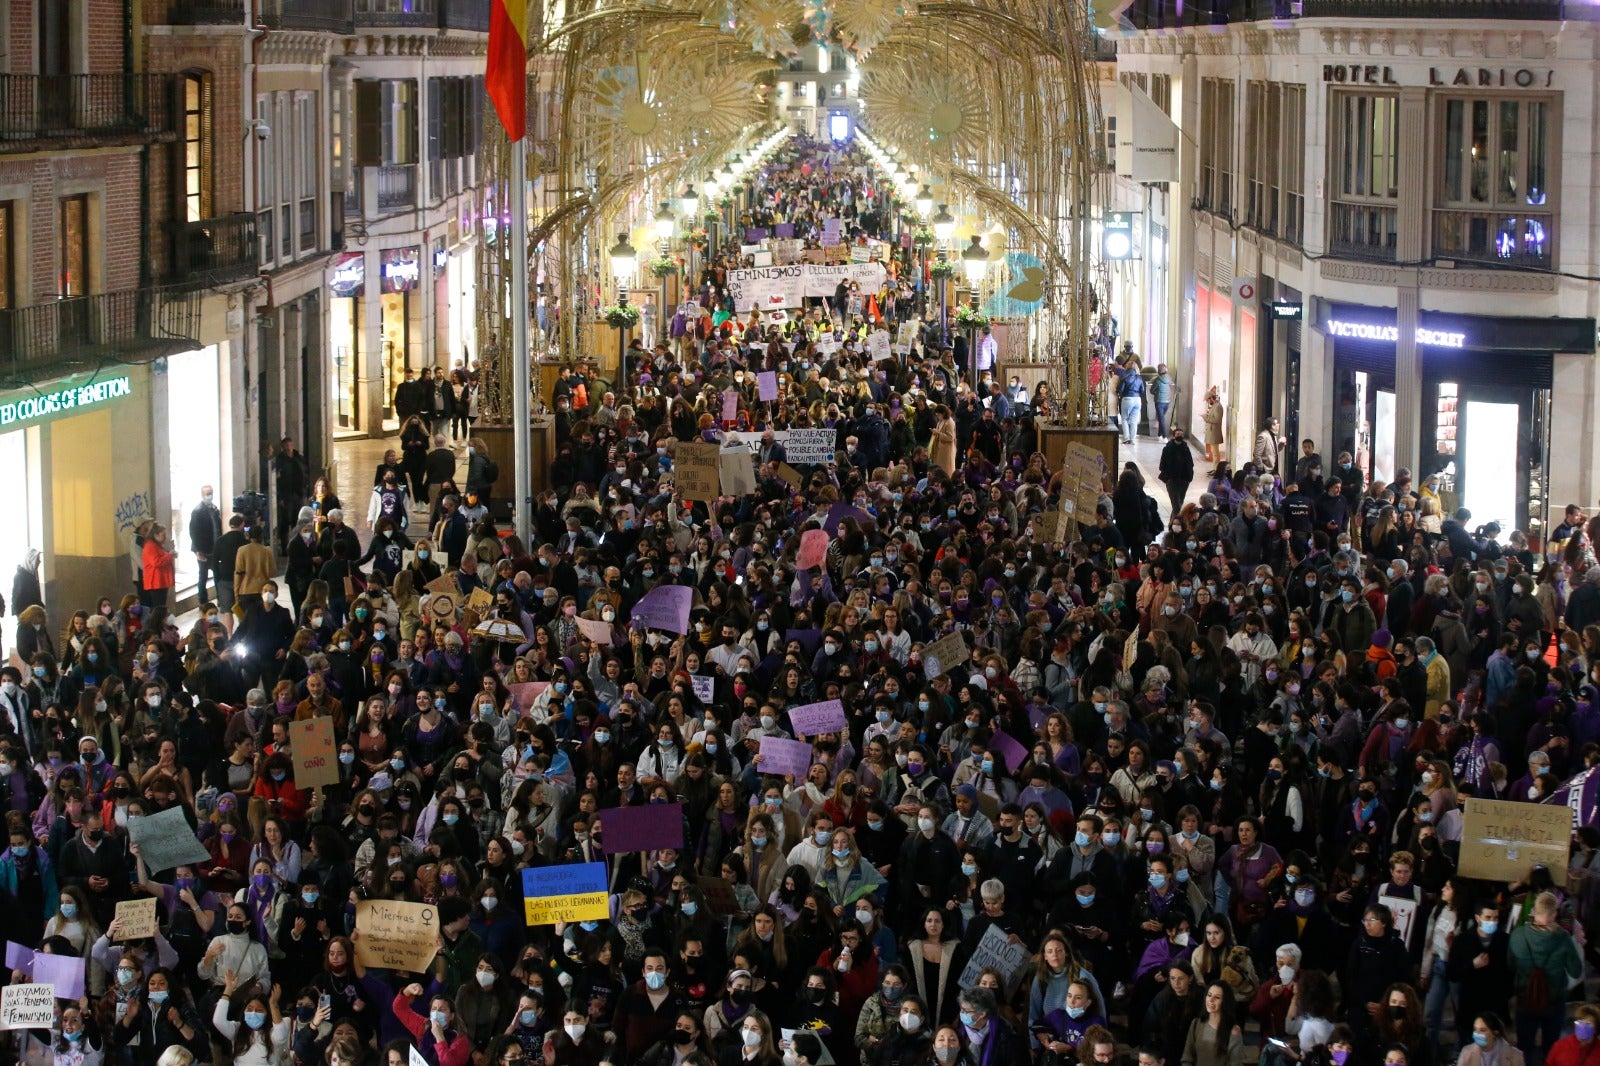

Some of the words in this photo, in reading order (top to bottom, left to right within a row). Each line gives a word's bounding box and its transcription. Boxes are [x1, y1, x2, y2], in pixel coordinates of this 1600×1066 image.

[1323, 64, 1397, 84] HOTEL
[729, 265, 802, 281] FEMINISMOS
[728, 282, 742, 291] CON
[1327, 320, 1399, 341] VICTORIA'S
[1416, 328, 1466, 348] SECRET
[17, 392, 61, 420] COLORS
[61, 389, 77, 409] OF
[816, 430, 836, 438] ACTUAR
[304, 756, 326, 769] COÑO
[371, 904, 415, 923] Mientras
[16, 987, 51, 997] ESTAMOS
[24, 997, 53, 1007] TENEMOS
